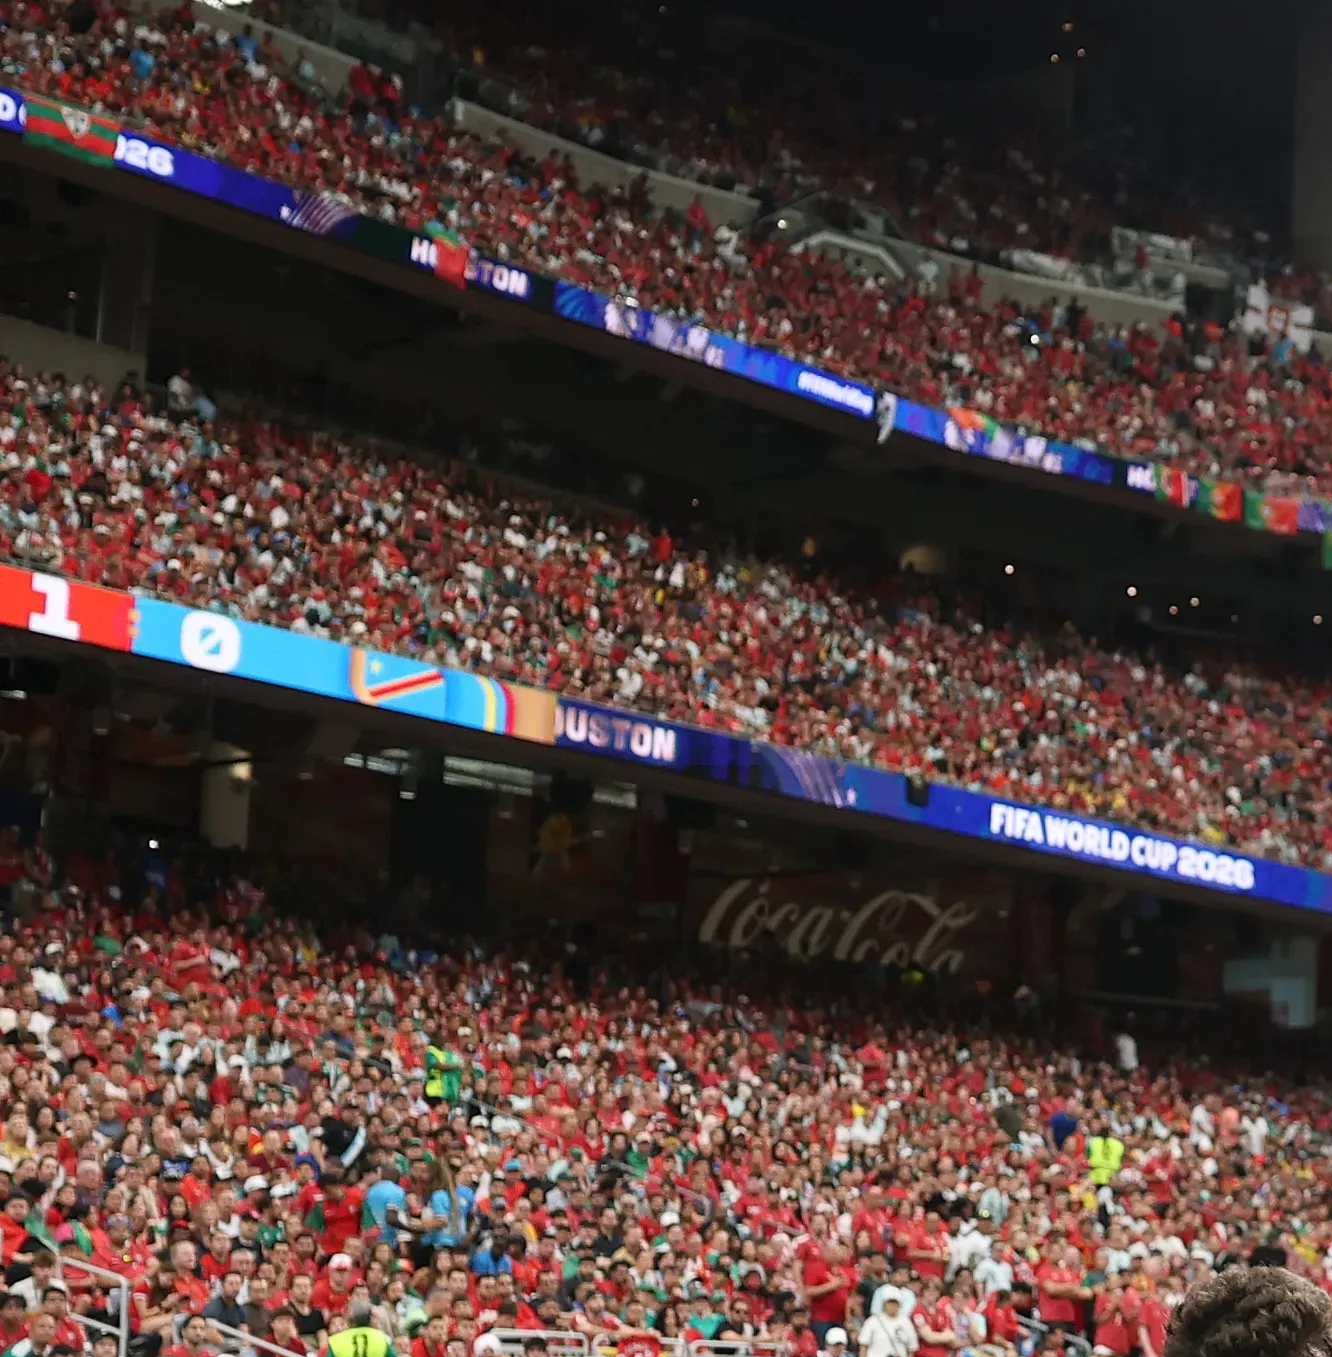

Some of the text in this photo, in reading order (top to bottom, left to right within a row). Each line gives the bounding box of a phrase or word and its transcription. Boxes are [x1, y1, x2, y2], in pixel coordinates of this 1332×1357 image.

[410, 236, 529, 297] HSTON
[28, 572, 80, 641] 1
[181, 611, 241, 673] 0
[990, 803, 1255, 890] FIFA WORLD CUP 2026
